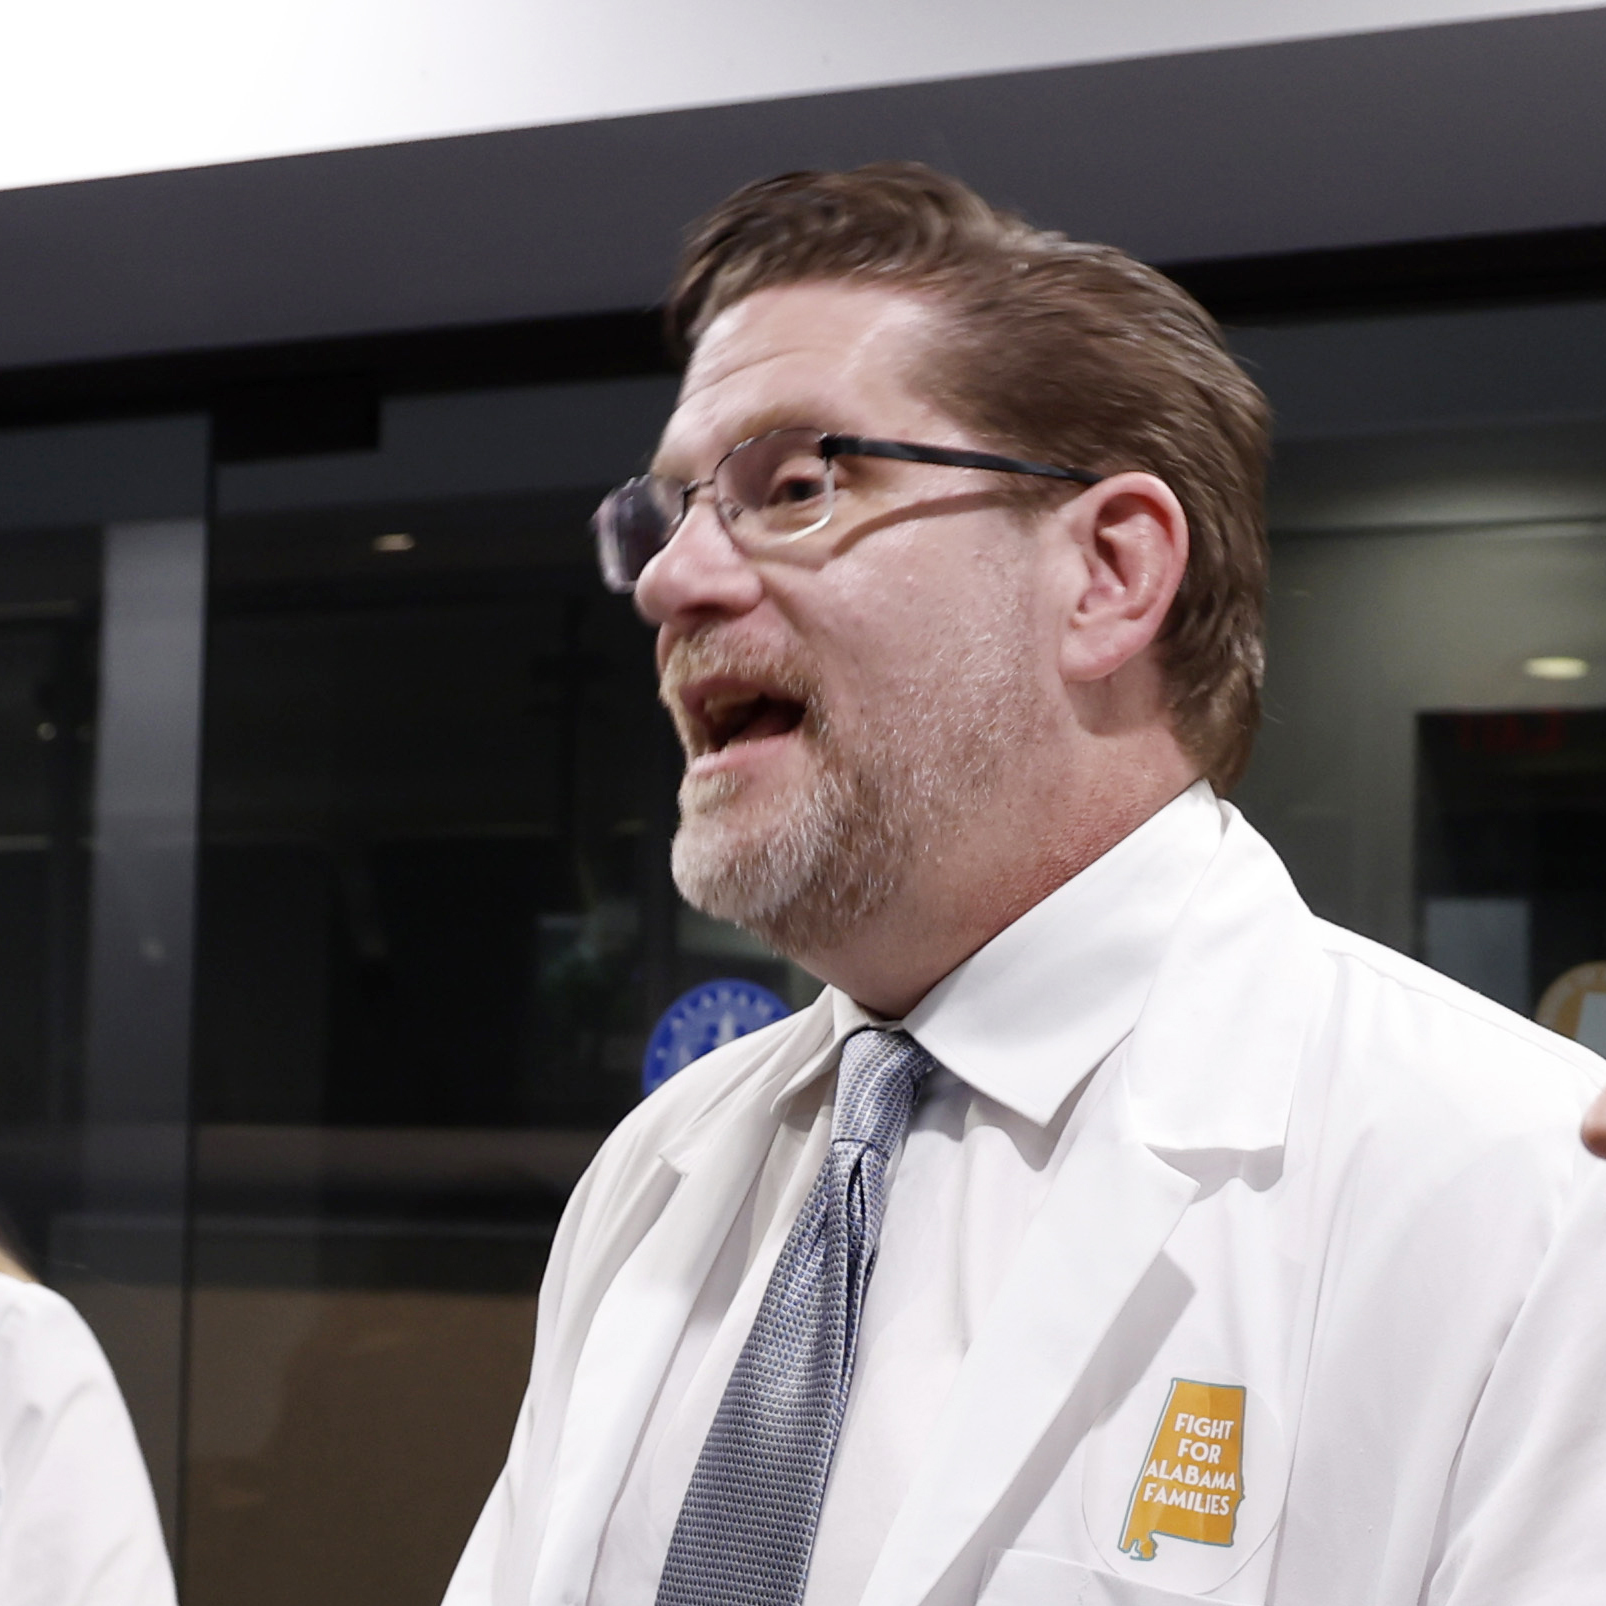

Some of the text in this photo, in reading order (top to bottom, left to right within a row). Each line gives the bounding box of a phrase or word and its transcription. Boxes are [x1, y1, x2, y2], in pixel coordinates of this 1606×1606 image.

[1174, 1412, 1234, 1440] FIGHT
[1177, 1438, 1222, 1464] FOR
[1145, 1459, 1236, 1491] ALABAMA
[1143, 1483, 1230, 1516] FAMILIES
